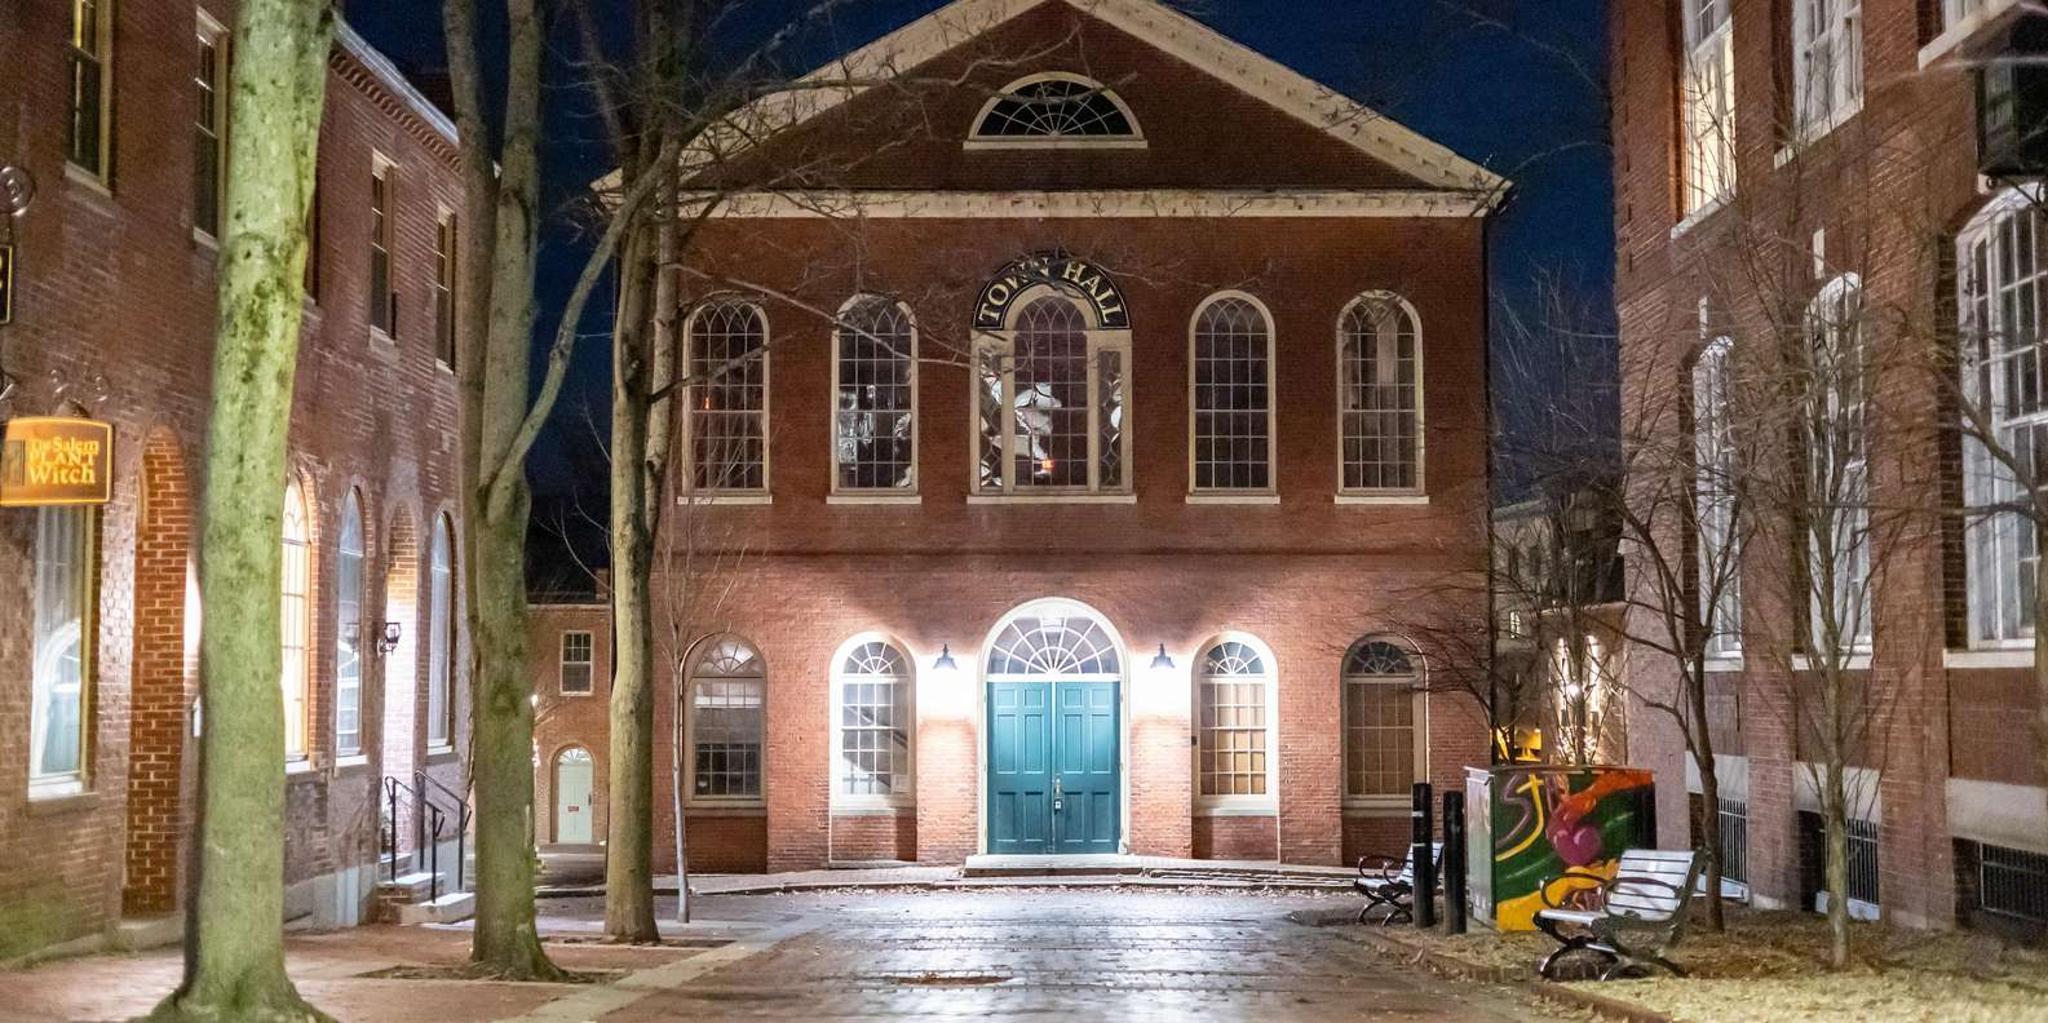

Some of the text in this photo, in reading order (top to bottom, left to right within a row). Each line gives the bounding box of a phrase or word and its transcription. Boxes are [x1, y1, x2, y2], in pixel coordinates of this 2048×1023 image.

[1062, 261, 1122, 323] HALL
[53, 436, 99, 453] Salem
[29, 449, 97, 466] PLANT
[29, 465, 96, 484] Witch
